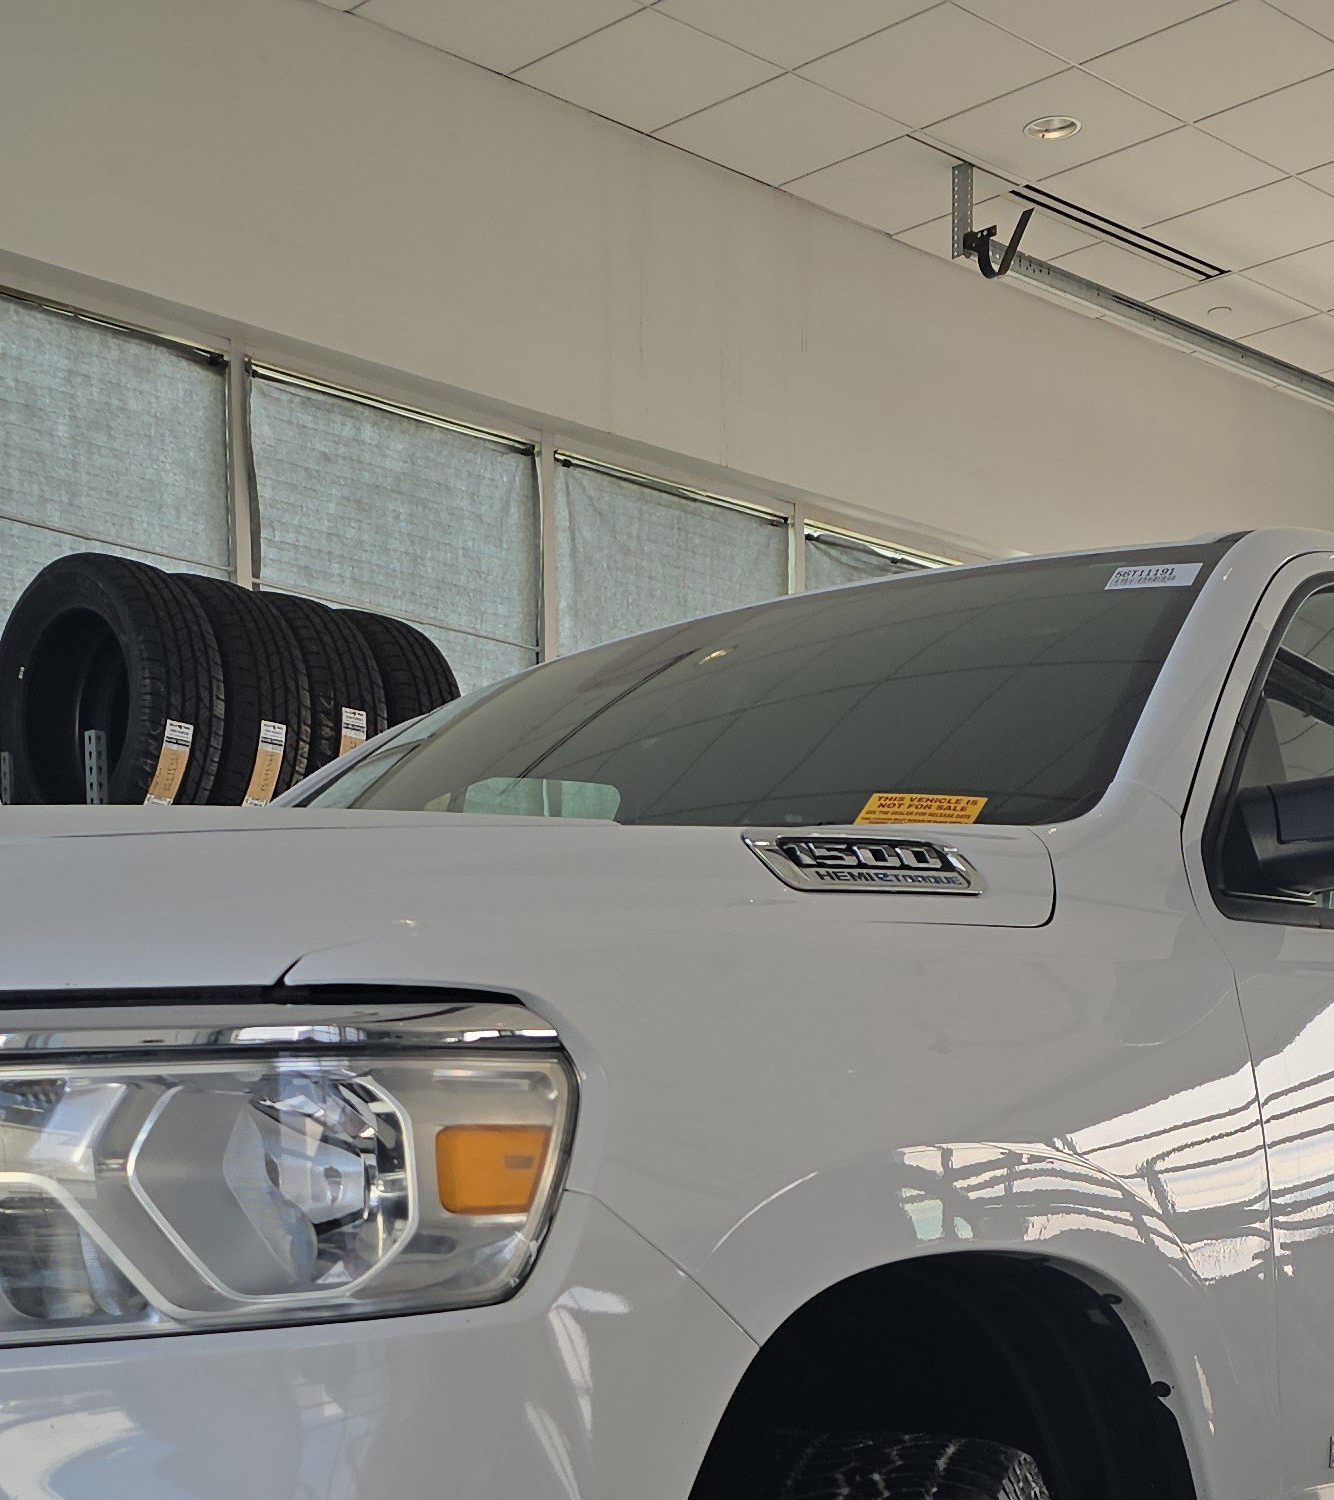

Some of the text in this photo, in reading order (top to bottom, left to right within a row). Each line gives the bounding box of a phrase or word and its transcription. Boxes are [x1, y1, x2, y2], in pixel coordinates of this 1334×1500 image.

[909, 796, 963, 805] VEHICLE
[936, 804, 969, 812] SALE
[783, 842, 943, 869] 1500
